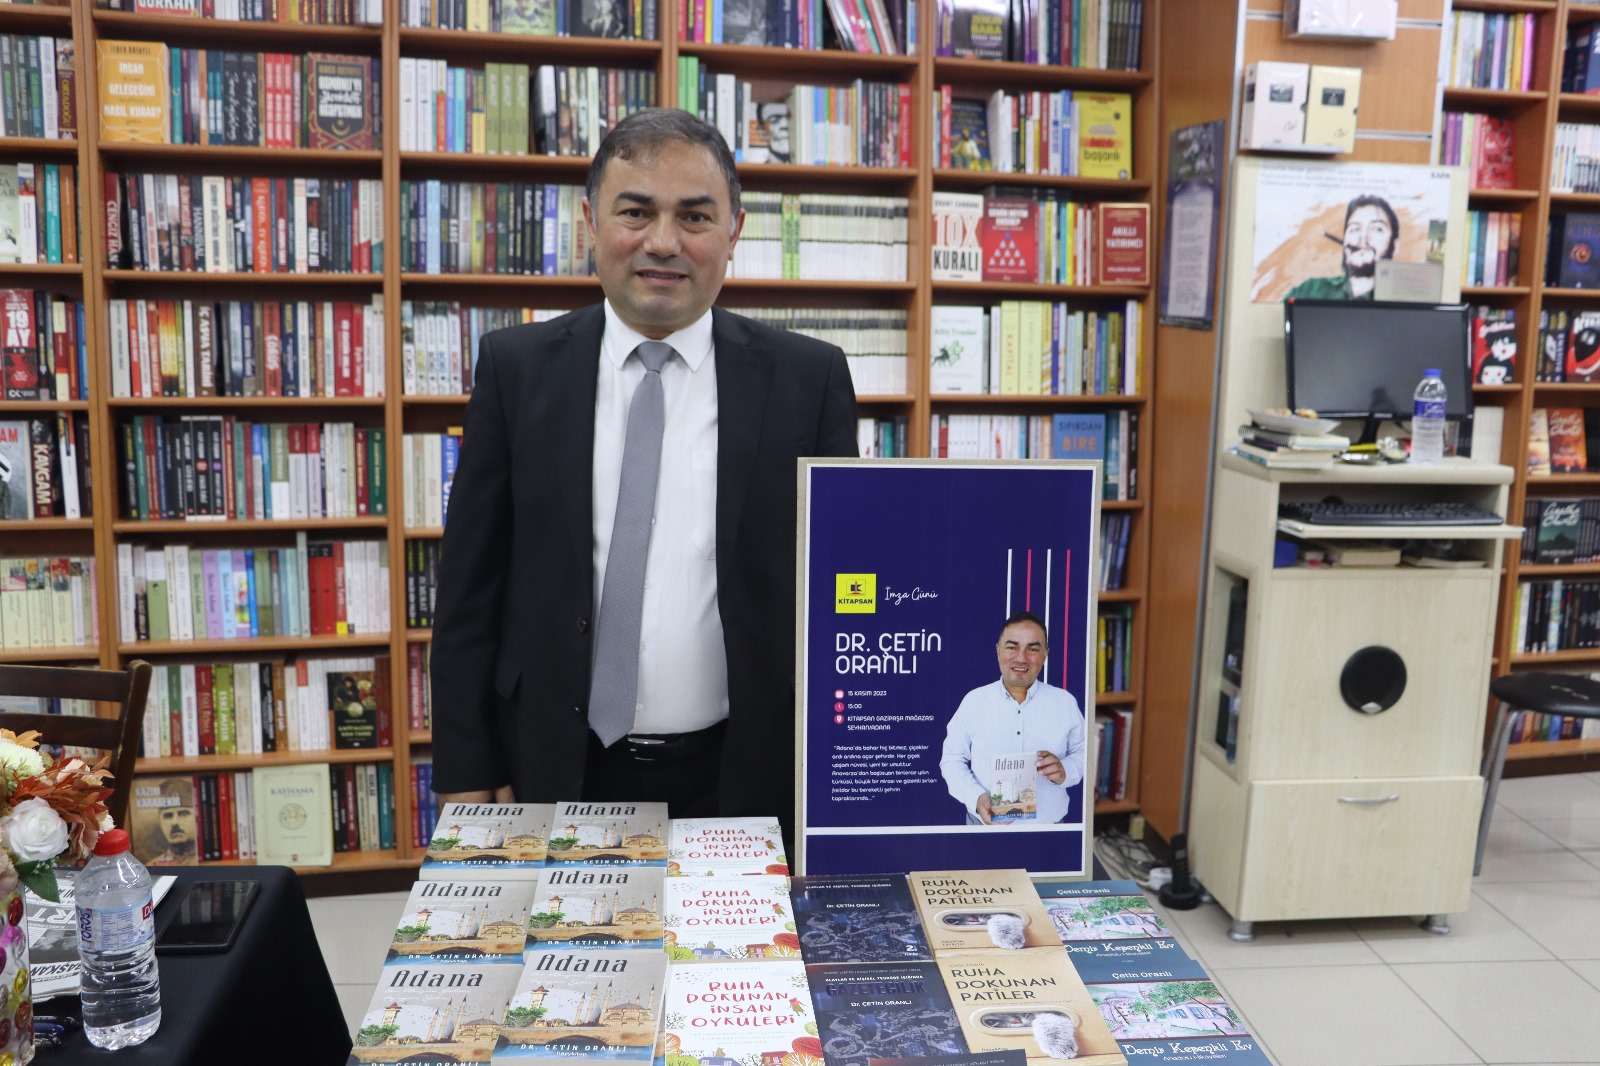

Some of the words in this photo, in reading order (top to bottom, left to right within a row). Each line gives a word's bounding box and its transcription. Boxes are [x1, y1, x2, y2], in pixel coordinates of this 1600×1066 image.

[933, 249, 979, 271] KURALI
[6, 310, 29, 329] 19
[6, 328, 31, 347] AY
[1062, 433, 1098, 452] BİRE
[33, 443, 51, 505] KAVGAM
[911, 586, 939, 600] Günü
[836, 632, 871, 652] DR.
[878, 629, 942, 659] ÇETİN
[835, 654, 917, 674] ORANLI
[220, 713, 229, 741] MISIR
[995, 758, 1025, 771] Adana
[451, 804, 524, 816] Adana
[564, 804, 636, 816] Adana
[685, 836, 765, 844] DOKUNAN
[548, 870, 629, 885] Adana
[922, 879, 969, 887] RUHA
[420, 882, 502, 897] Adana
[702, 889, 751, 898] RUHA
[925, 887, 1012, 896] DOKUNAN
[682, 898, 772, 908] DOKUNAN
[927, 895, 994, 905] PATİLER
[703, 908, 757, 916] İNSAN
[80, 908, 92, 943] TOROS
[535, 953, 629, 972] Adana
[389, 969, 484, 988] Adana
[951, 968, 1005, 978] RUHA
[709, 980, 764, 992] RUHA
[956, 977, 1057, 990] DOKUNAN
[686, 992, 788, 1004] DOKUNAN
[961, 988, 1036, 1002] PATİLER
[710, 1004, 772, 1014] İNSAN
[691, 1014, 796, 1028] ÖYKÜLERİ
[544, 1044, 578, 1052] ÇETİN
[1169, 1042, 1228, 1055] Kepenkli
[1231, 1040, 1252, 1050] Ev
